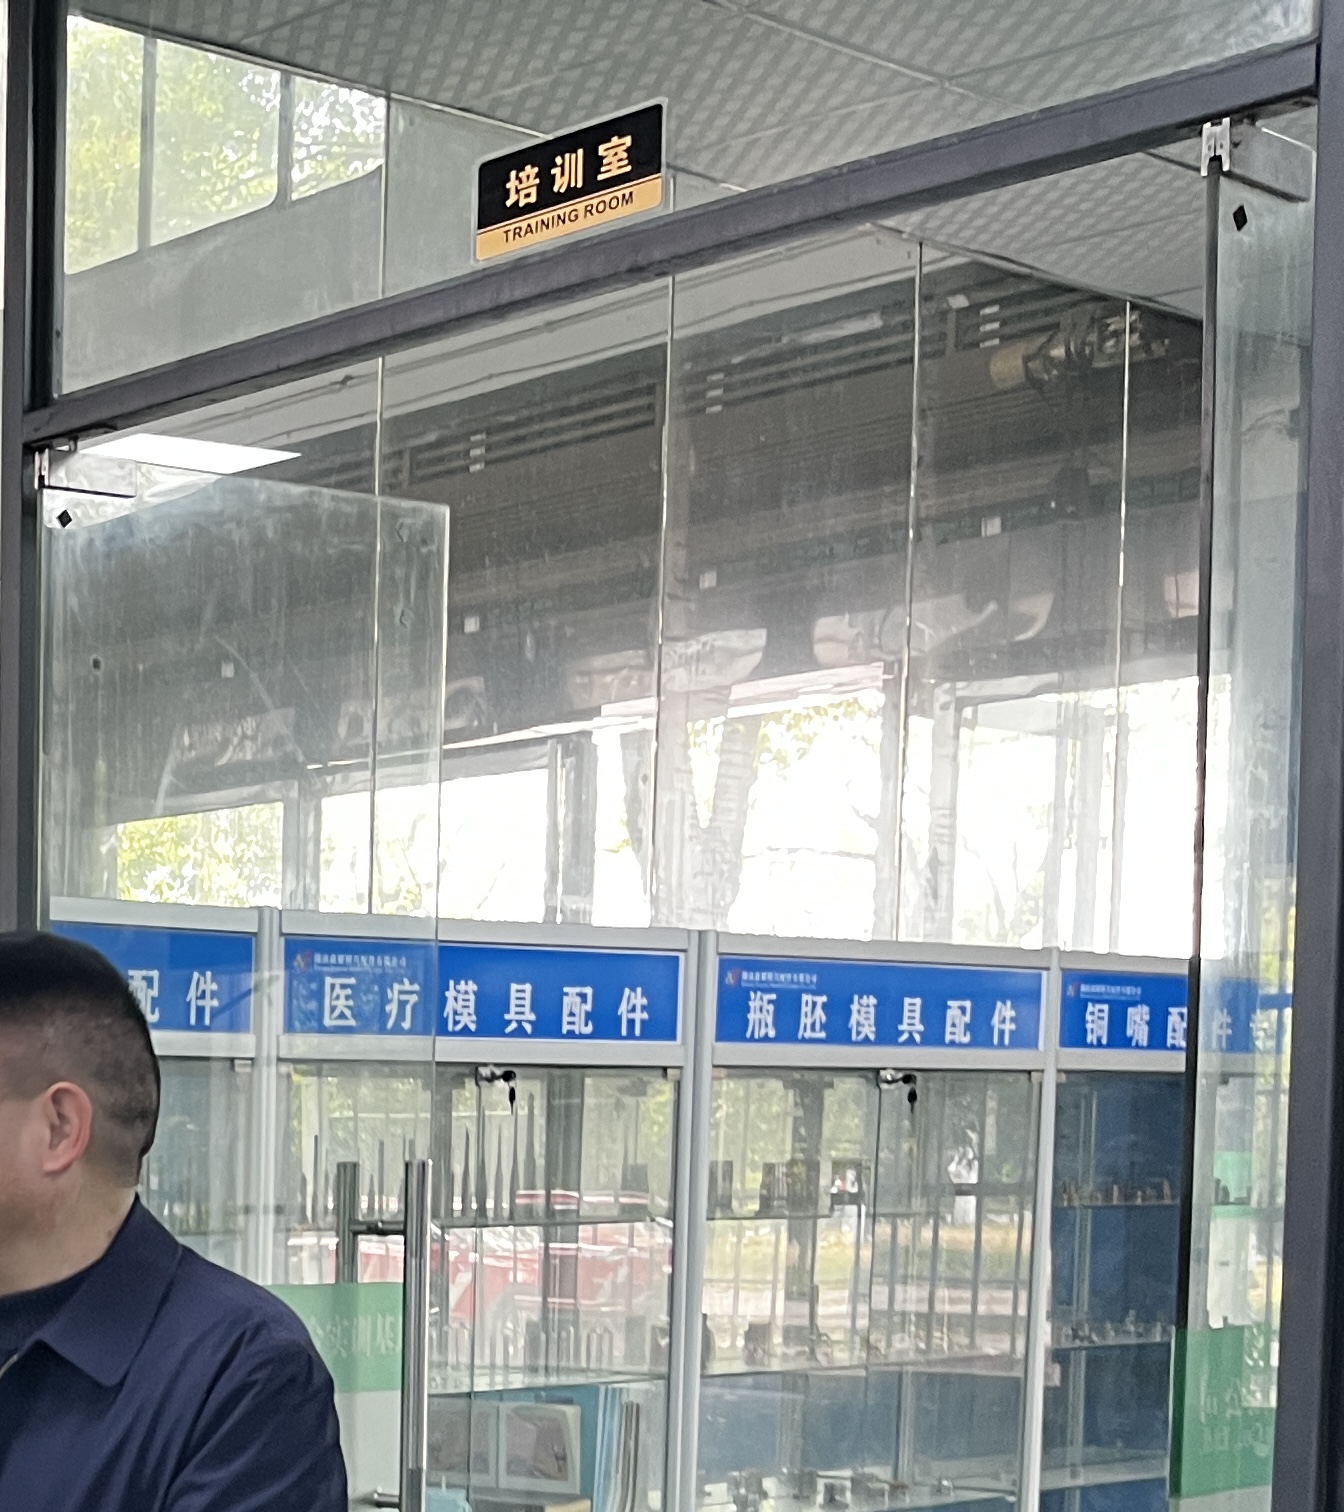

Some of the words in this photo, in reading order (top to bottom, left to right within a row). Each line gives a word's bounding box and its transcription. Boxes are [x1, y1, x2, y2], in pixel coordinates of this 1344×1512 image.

[504, 134, 633, 209] 培训室
[502, 208, 579, 244] TRAINING
[583, 190, 635, 219] ROOM
[322, 975, 650, 1038] 医疗模具配件
[745, 990, 1018, 1046] 瓶胚模具配件
